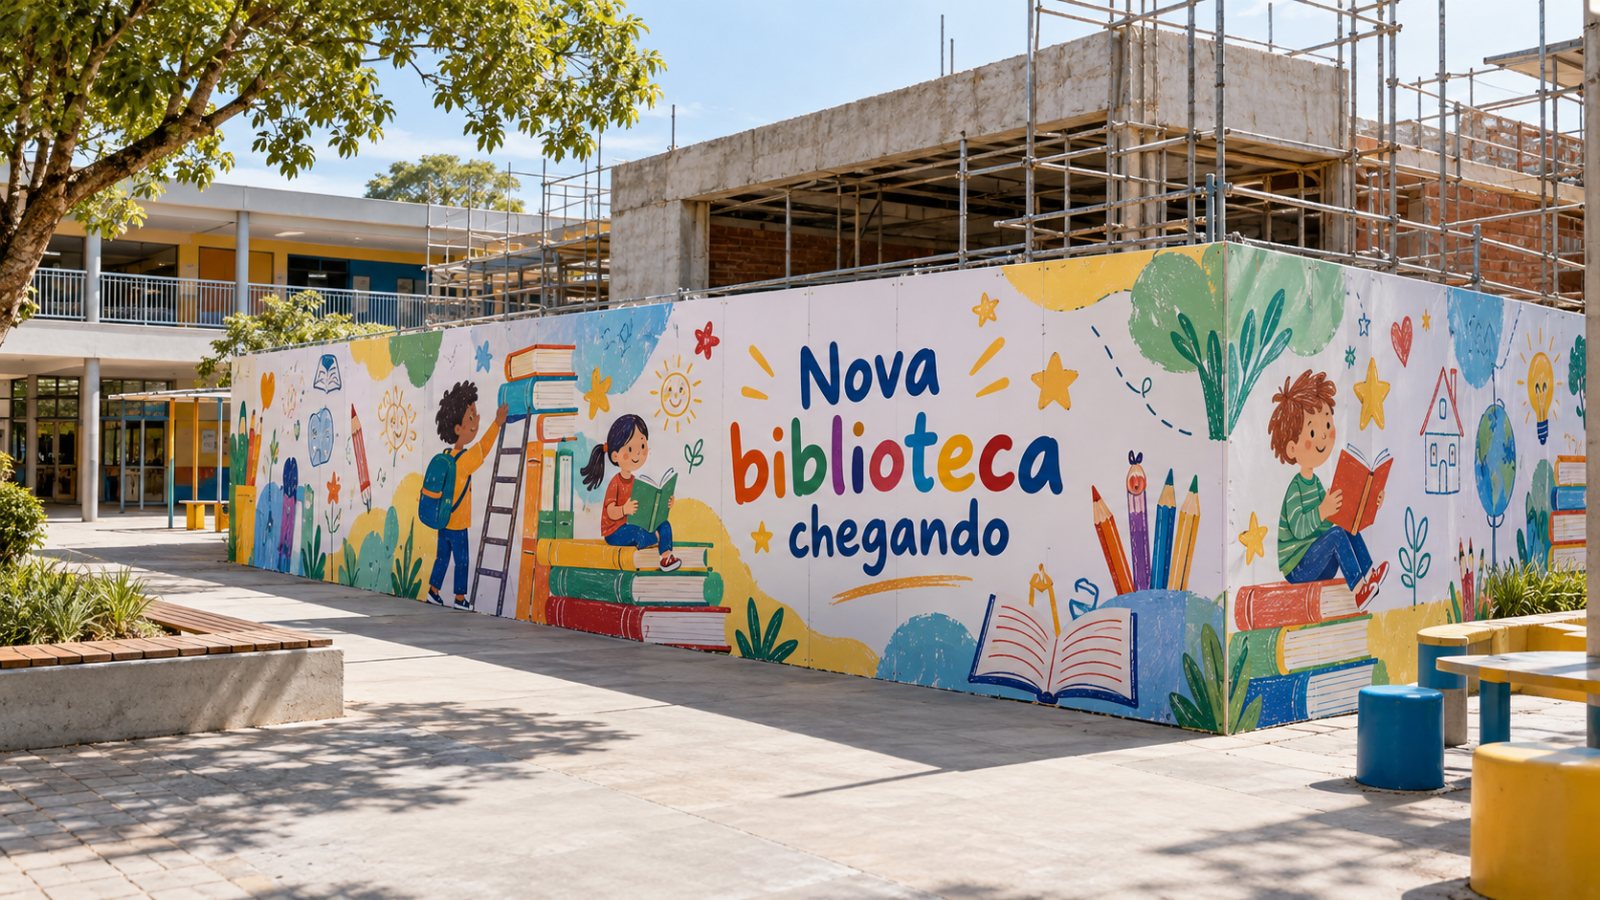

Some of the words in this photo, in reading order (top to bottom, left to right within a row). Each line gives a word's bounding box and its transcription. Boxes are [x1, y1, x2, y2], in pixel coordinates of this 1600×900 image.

[800, 341, 940, 410] Nova
[730, 411, 1063, 505] biblioteca
[789, 498, 1010, 577] chegando
